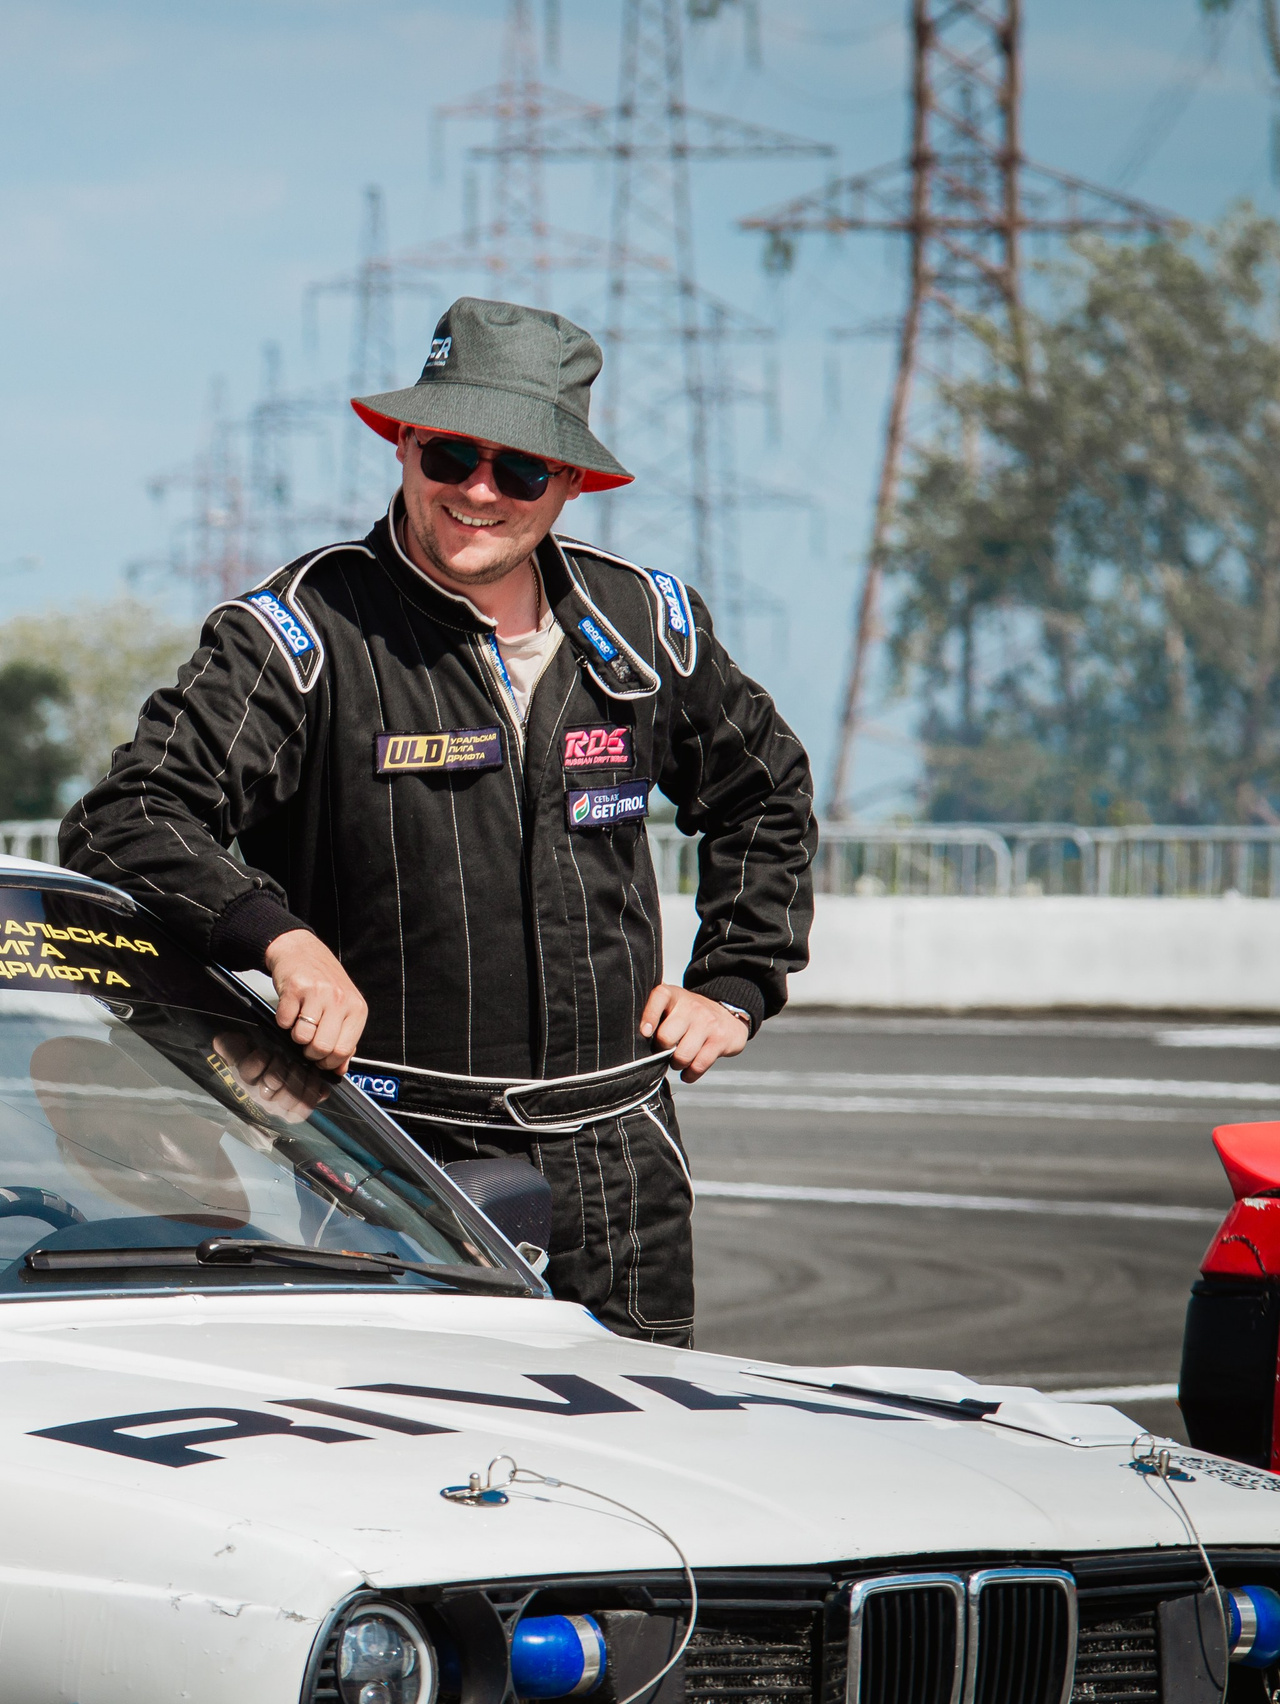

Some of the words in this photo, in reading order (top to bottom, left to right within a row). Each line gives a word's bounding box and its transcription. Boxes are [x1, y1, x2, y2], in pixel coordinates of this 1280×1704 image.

[252, 595, 309, 652] sparco
[581, 619, 612, 655] sparco
[449, 732, 497, 745] УРАЛЬСКАЯ
[565, 728, 628, 758] RDS
[388, 738, 445, 765] ULD
[445, 752, 486, 764] ДРИФТА
[448, 744, 474, 754] ЛИГА
[594, 795, 610, 804] СЕТЬ
[592, 803, 616, 819] GET
[344, 1072, 397, 1097] arco
